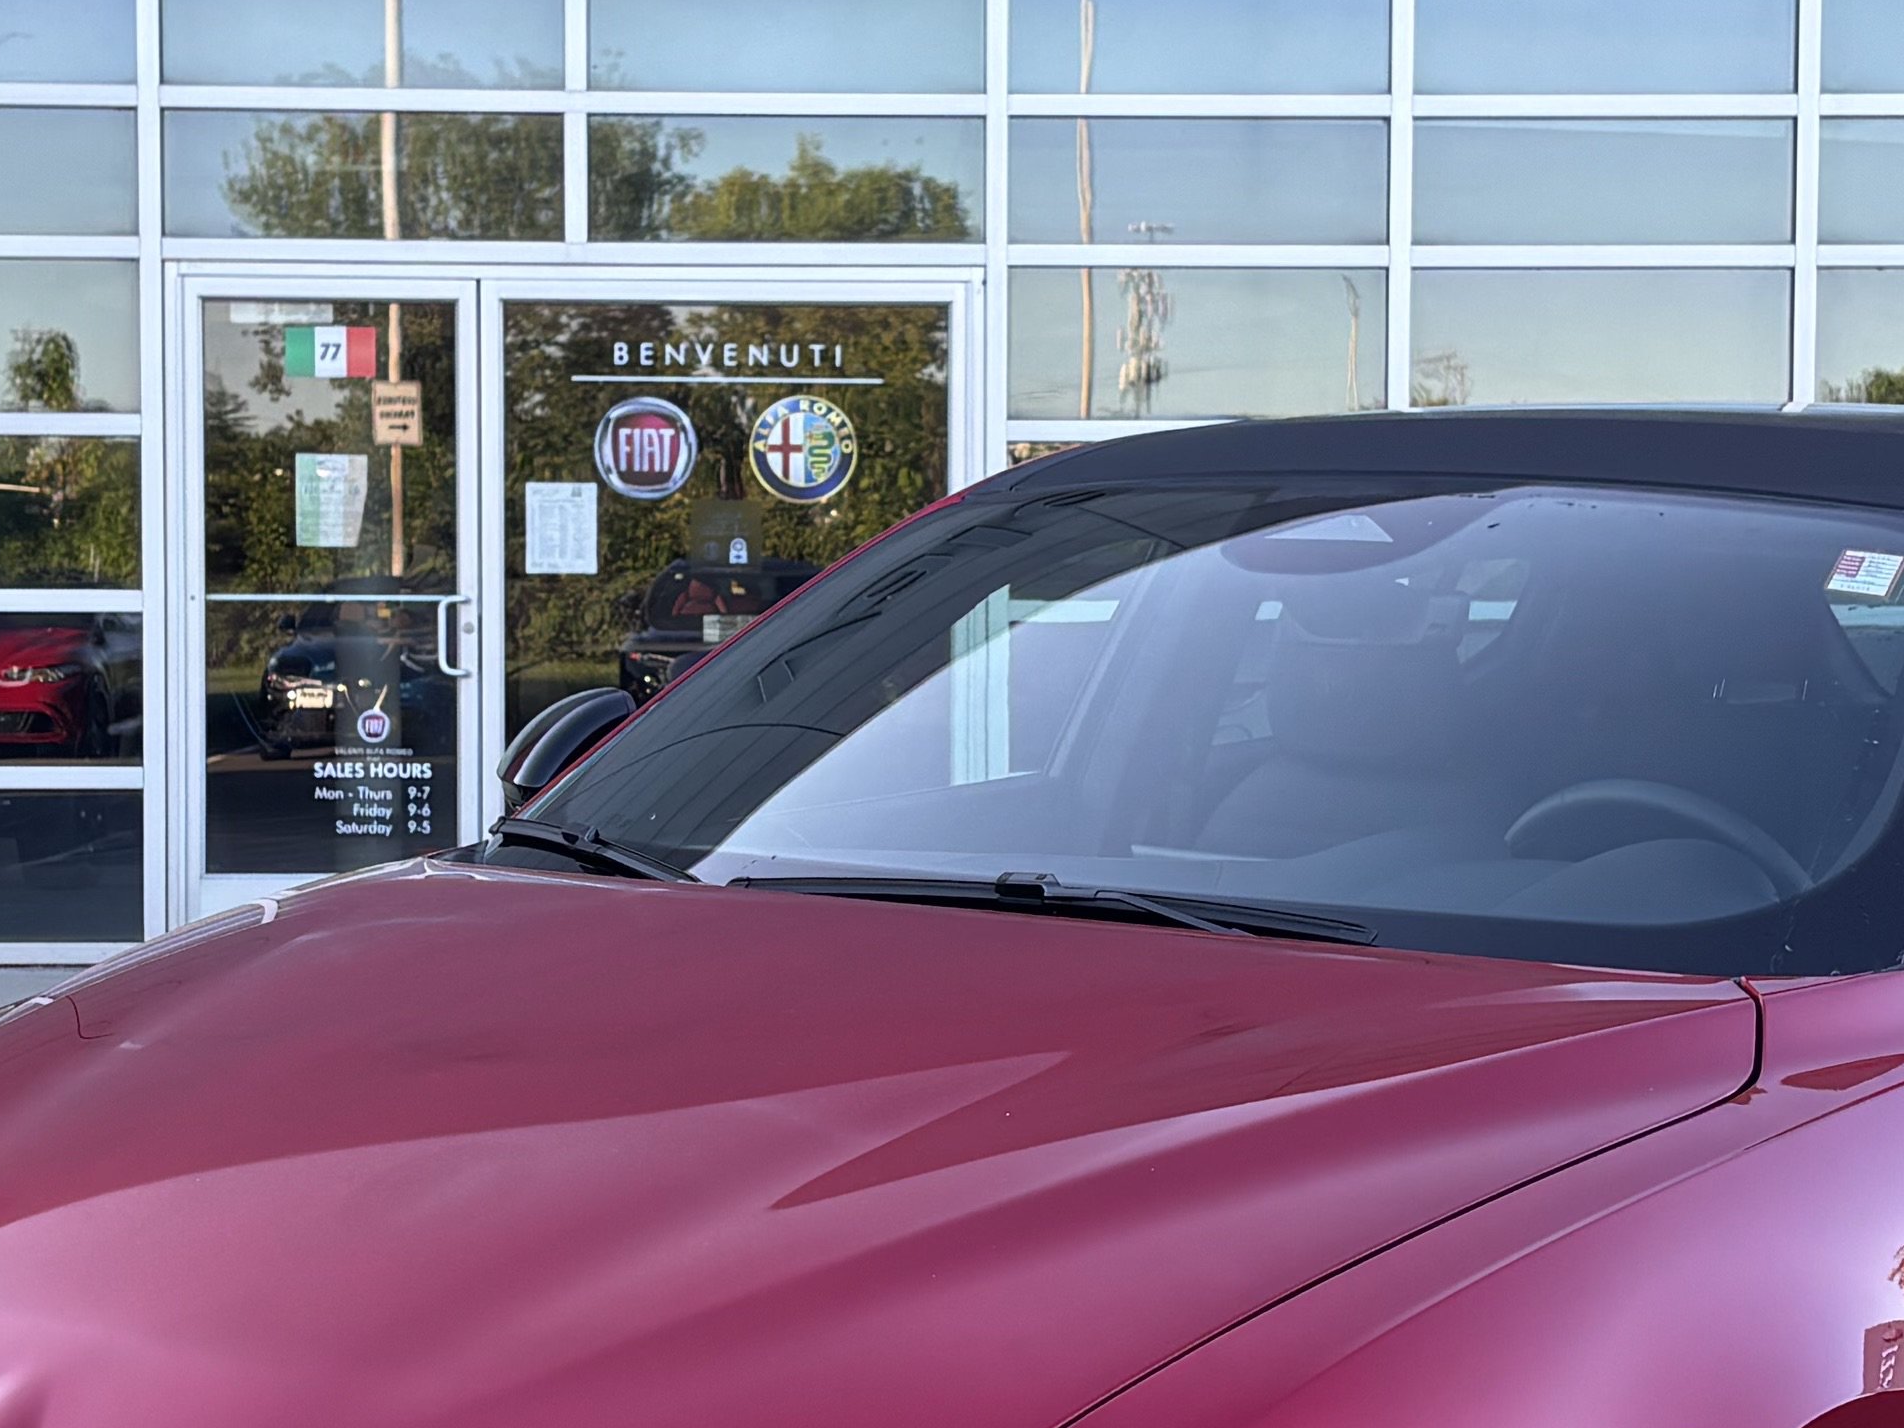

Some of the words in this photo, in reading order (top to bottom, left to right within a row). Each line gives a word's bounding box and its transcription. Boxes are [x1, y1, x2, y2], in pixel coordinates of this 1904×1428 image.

[319, 342, 342, 361] 77
[613, 341, 843, 368] BENVENUTI
[755, 406, 788, 453] ALFA
[799, 398, 853, 455] ROMEO
[618, 427, 676, 473] FIAT
[313, 762, 365, 779] SALES
[370, 762, 433, 779] HOURS
[314, 786, 345, 800] Mon
[357, 786, 393, 800] Thurs
[352, 803, 393, 820] Friday
[335, 820, 393, 837] Saturday
